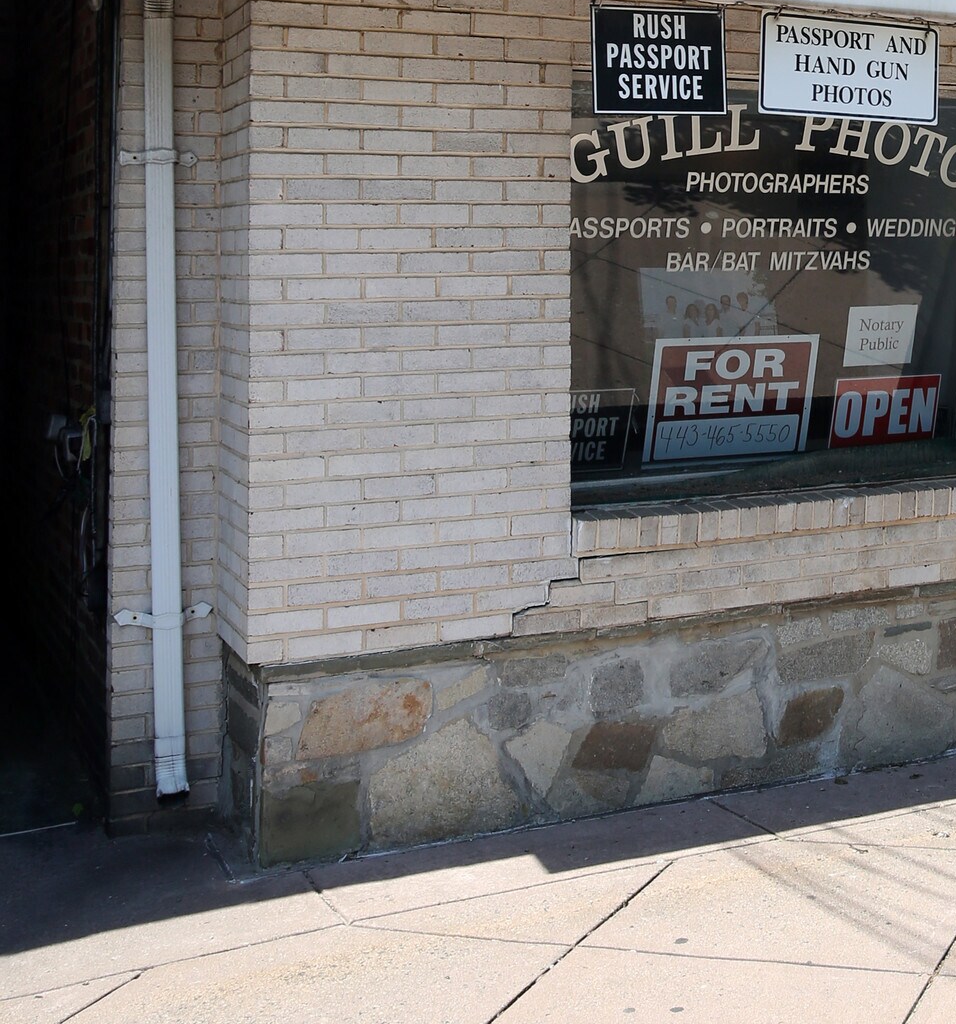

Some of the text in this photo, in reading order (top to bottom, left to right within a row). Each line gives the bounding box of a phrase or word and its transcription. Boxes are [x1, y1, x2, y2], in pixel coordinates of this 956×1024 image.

[632, 13, 686, 40] RUSH
[775, 24, 928, 57] PASSPORT AND
[606, 43, 712, 71] PASSPORT
[794, 53, 910, 82] HAND GUN
[618, 74, 704, 101] SERVICE
[811, 83, 893, 108] PHOTOS
[570, 104, 760, 184] GUILL
[685, 171, 870, 195] PHOTOGRAPHERS
[720, 217, 838, 239] PORTRAITS
[665, 249, 871, 273] BAR/BAT MITZVAHS
[858, 318, 905, 333] Notary
[858, 336, 900, 351] Public
[683, 348, 786, 382] FOR
[662, 381, 800, 417] RENT
[833, 387, 937, 438] OPEN
[660, 423, 791, 453] 443-465-5550
